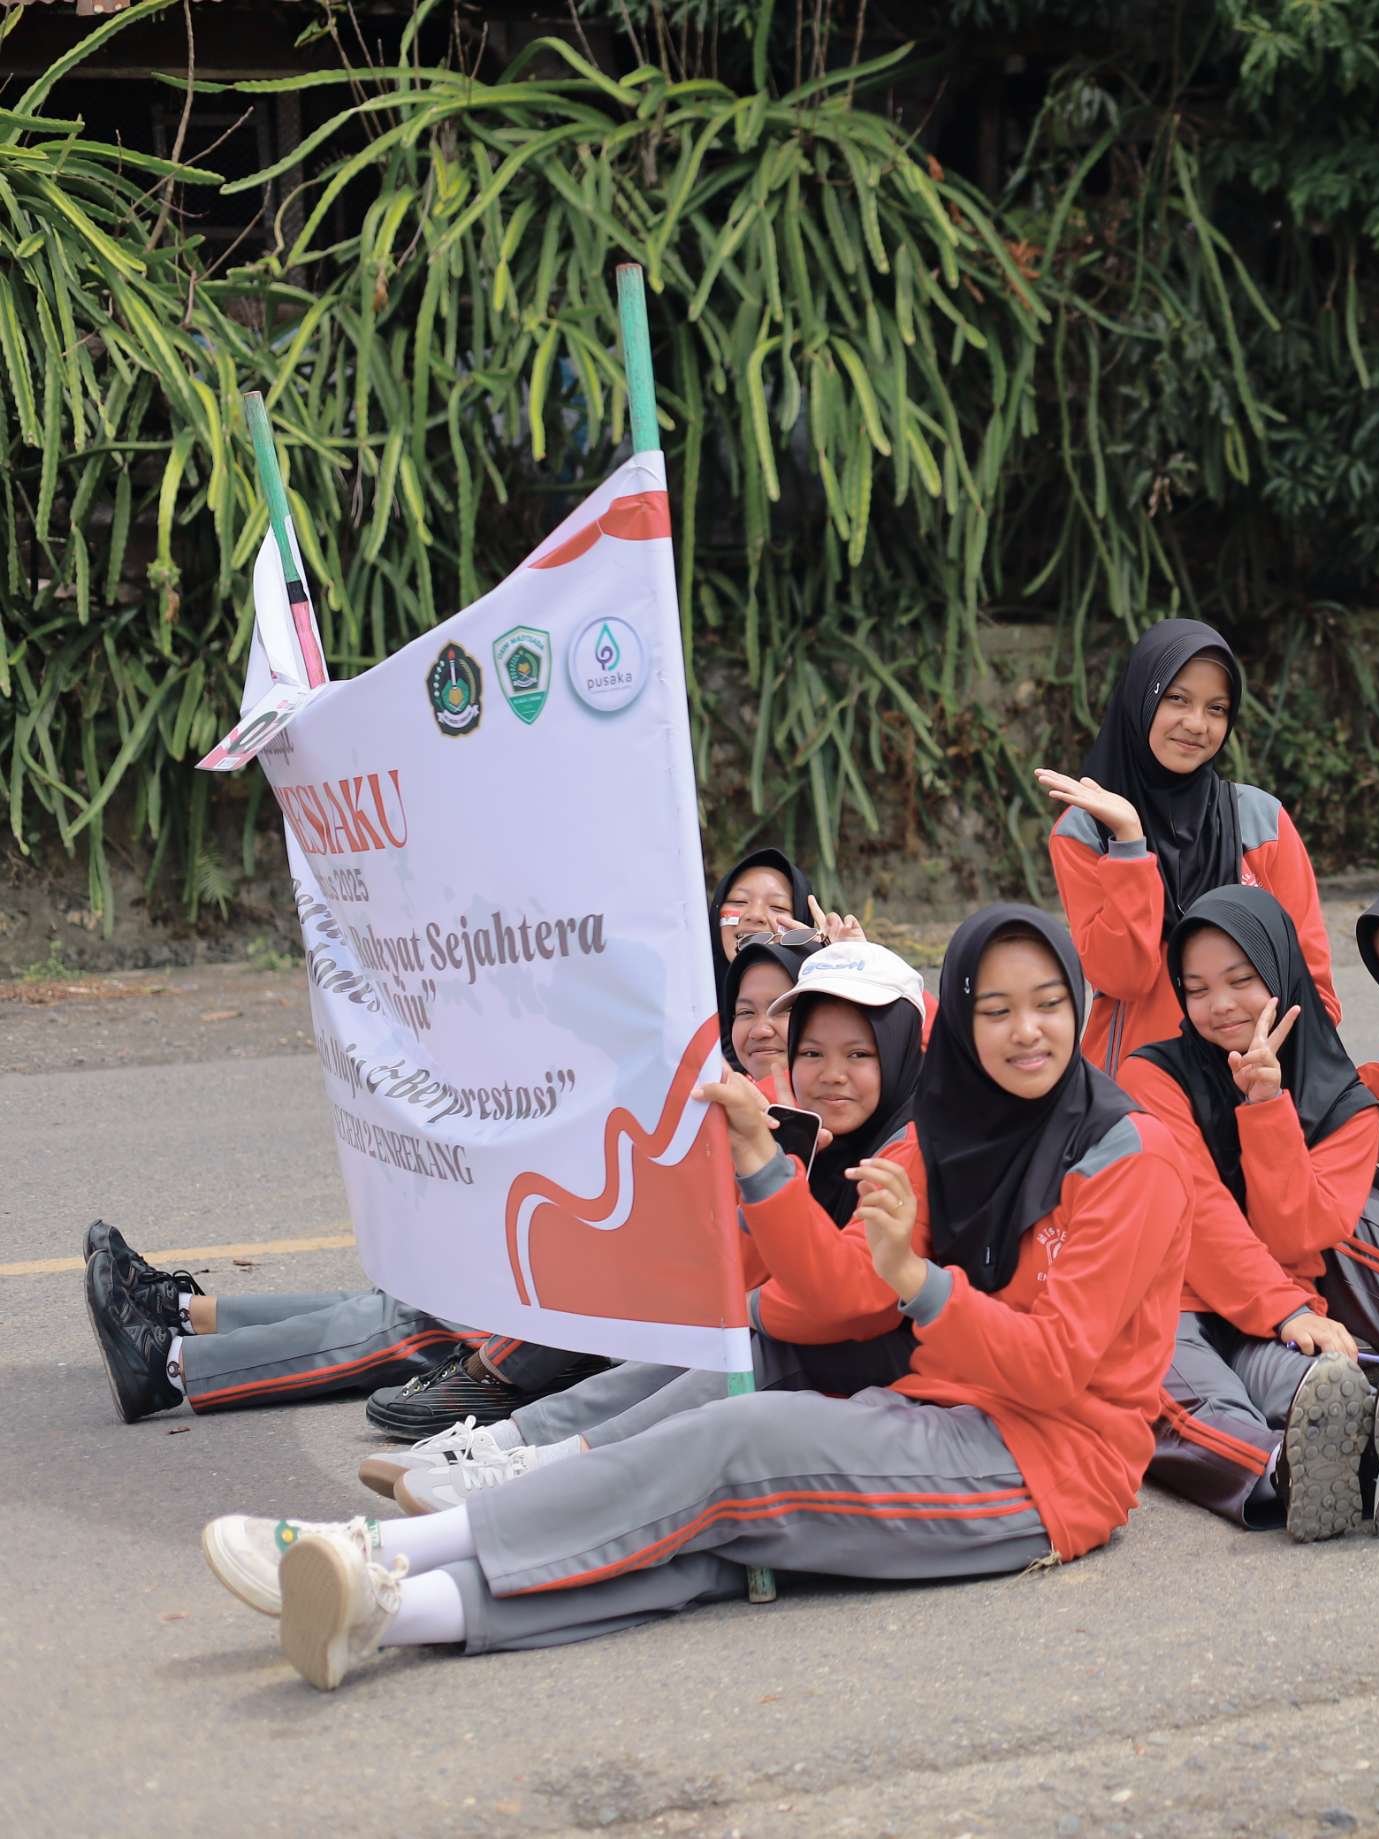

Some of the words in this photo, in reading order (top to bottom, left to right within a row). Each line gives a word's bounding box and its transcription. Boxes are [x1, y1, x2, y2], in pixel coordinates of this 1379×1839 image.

[586, 672, 632, 691] pusaka
[425, 911, 607, 985] Sejahtera
[372, 1125, 475, 1184] ENREKANG
